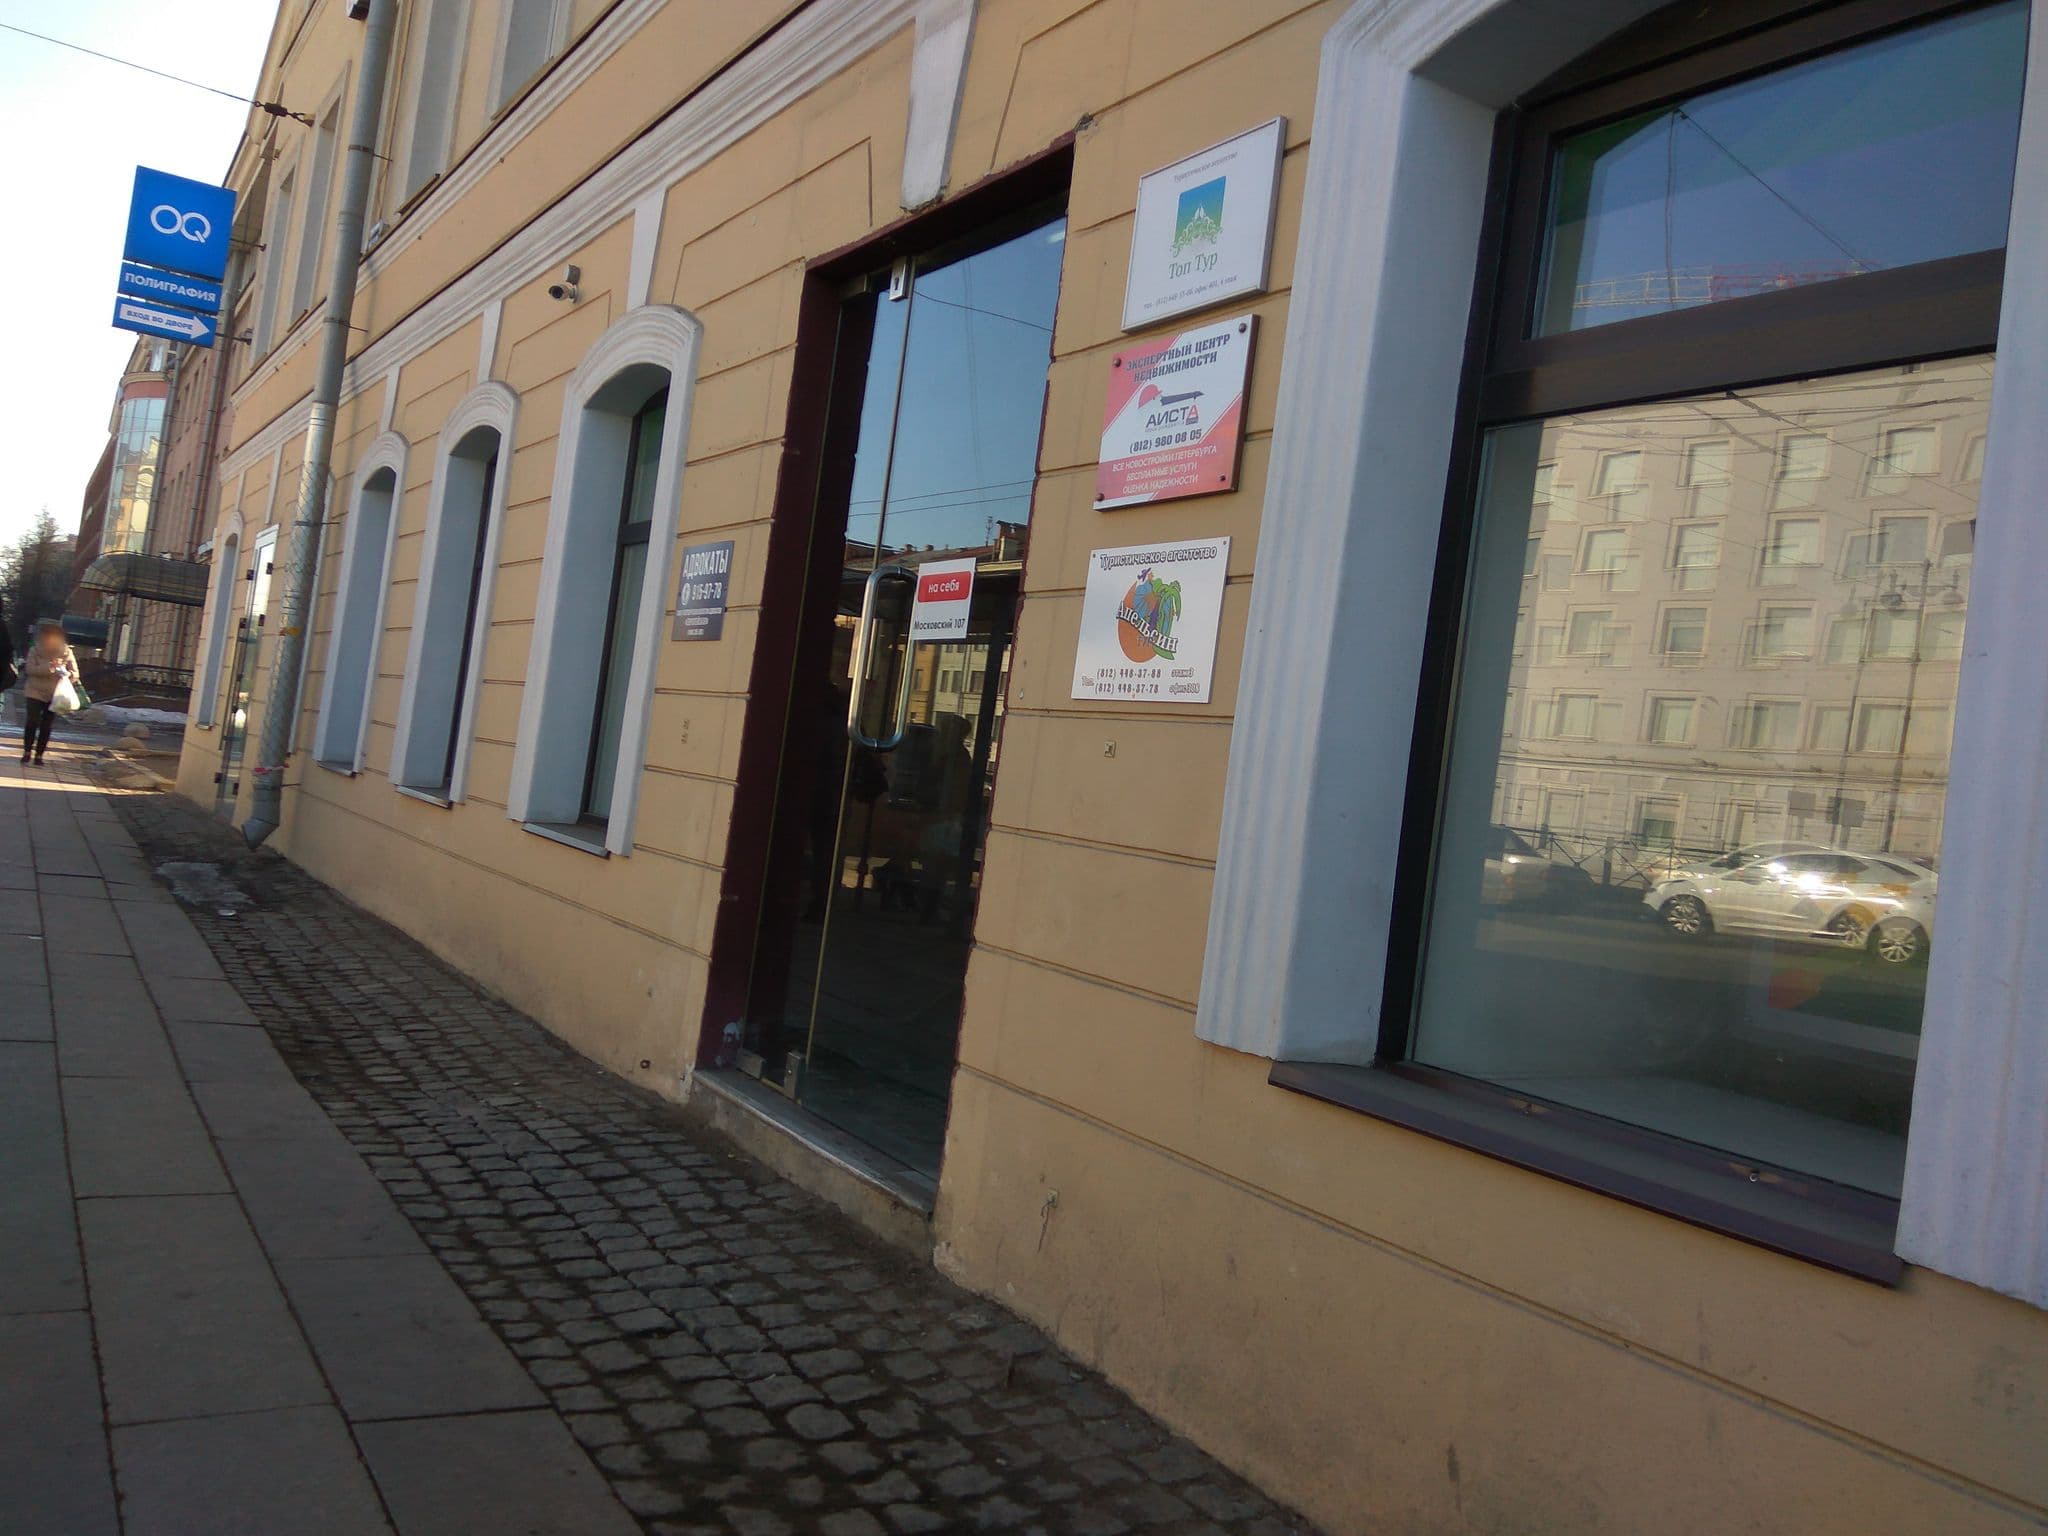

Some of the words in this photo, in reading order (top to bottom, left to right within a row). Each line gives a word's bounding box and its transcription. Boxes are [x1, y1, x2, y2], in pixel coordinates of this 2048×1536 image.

[1169, 260, 1190, 280] Топ
[1195, 250, 1218, 273] Тур
[124, 272, 216, 303] ПОЛИГРАФИЯ
[126, 310, 150, 321] ВХОД
[152, 315, 163, 324] ВО
[165, 318, 194, 330] ДВОРЕ
[1126, 343, 1192, 371] ЭКСПЕРТНЫЙ
[1195, 333, 1231, 353] ЦЕНТР
[1134, 351, 1218, 382] НЕДВИЖИМОСТИ
[1145, 404, 1199, 428] АИСТА
[1130, 440, 1152, 454] (812)
[1155, 434, 1173, 448] 980
[1175, 431, 1188, 444] 08
[1190, 429, 1202, 441] 05
[683, 549, 729, 579] АДВОКАТЫ
[1100, 551, 1166, 571] Туристическое
[1167, 546, 1217, 562] агентство
[928, 583, 937, 593] на
[940, 579, 960, 592] себя
[914, 619, 953, 630] Московский
[953, 618, 966, 629] 107
[1116, 601, 1179, 653] Апельсин
[1097, 668, 1116, 680] (812)
[1095, 683, 1114, 694] (812)
